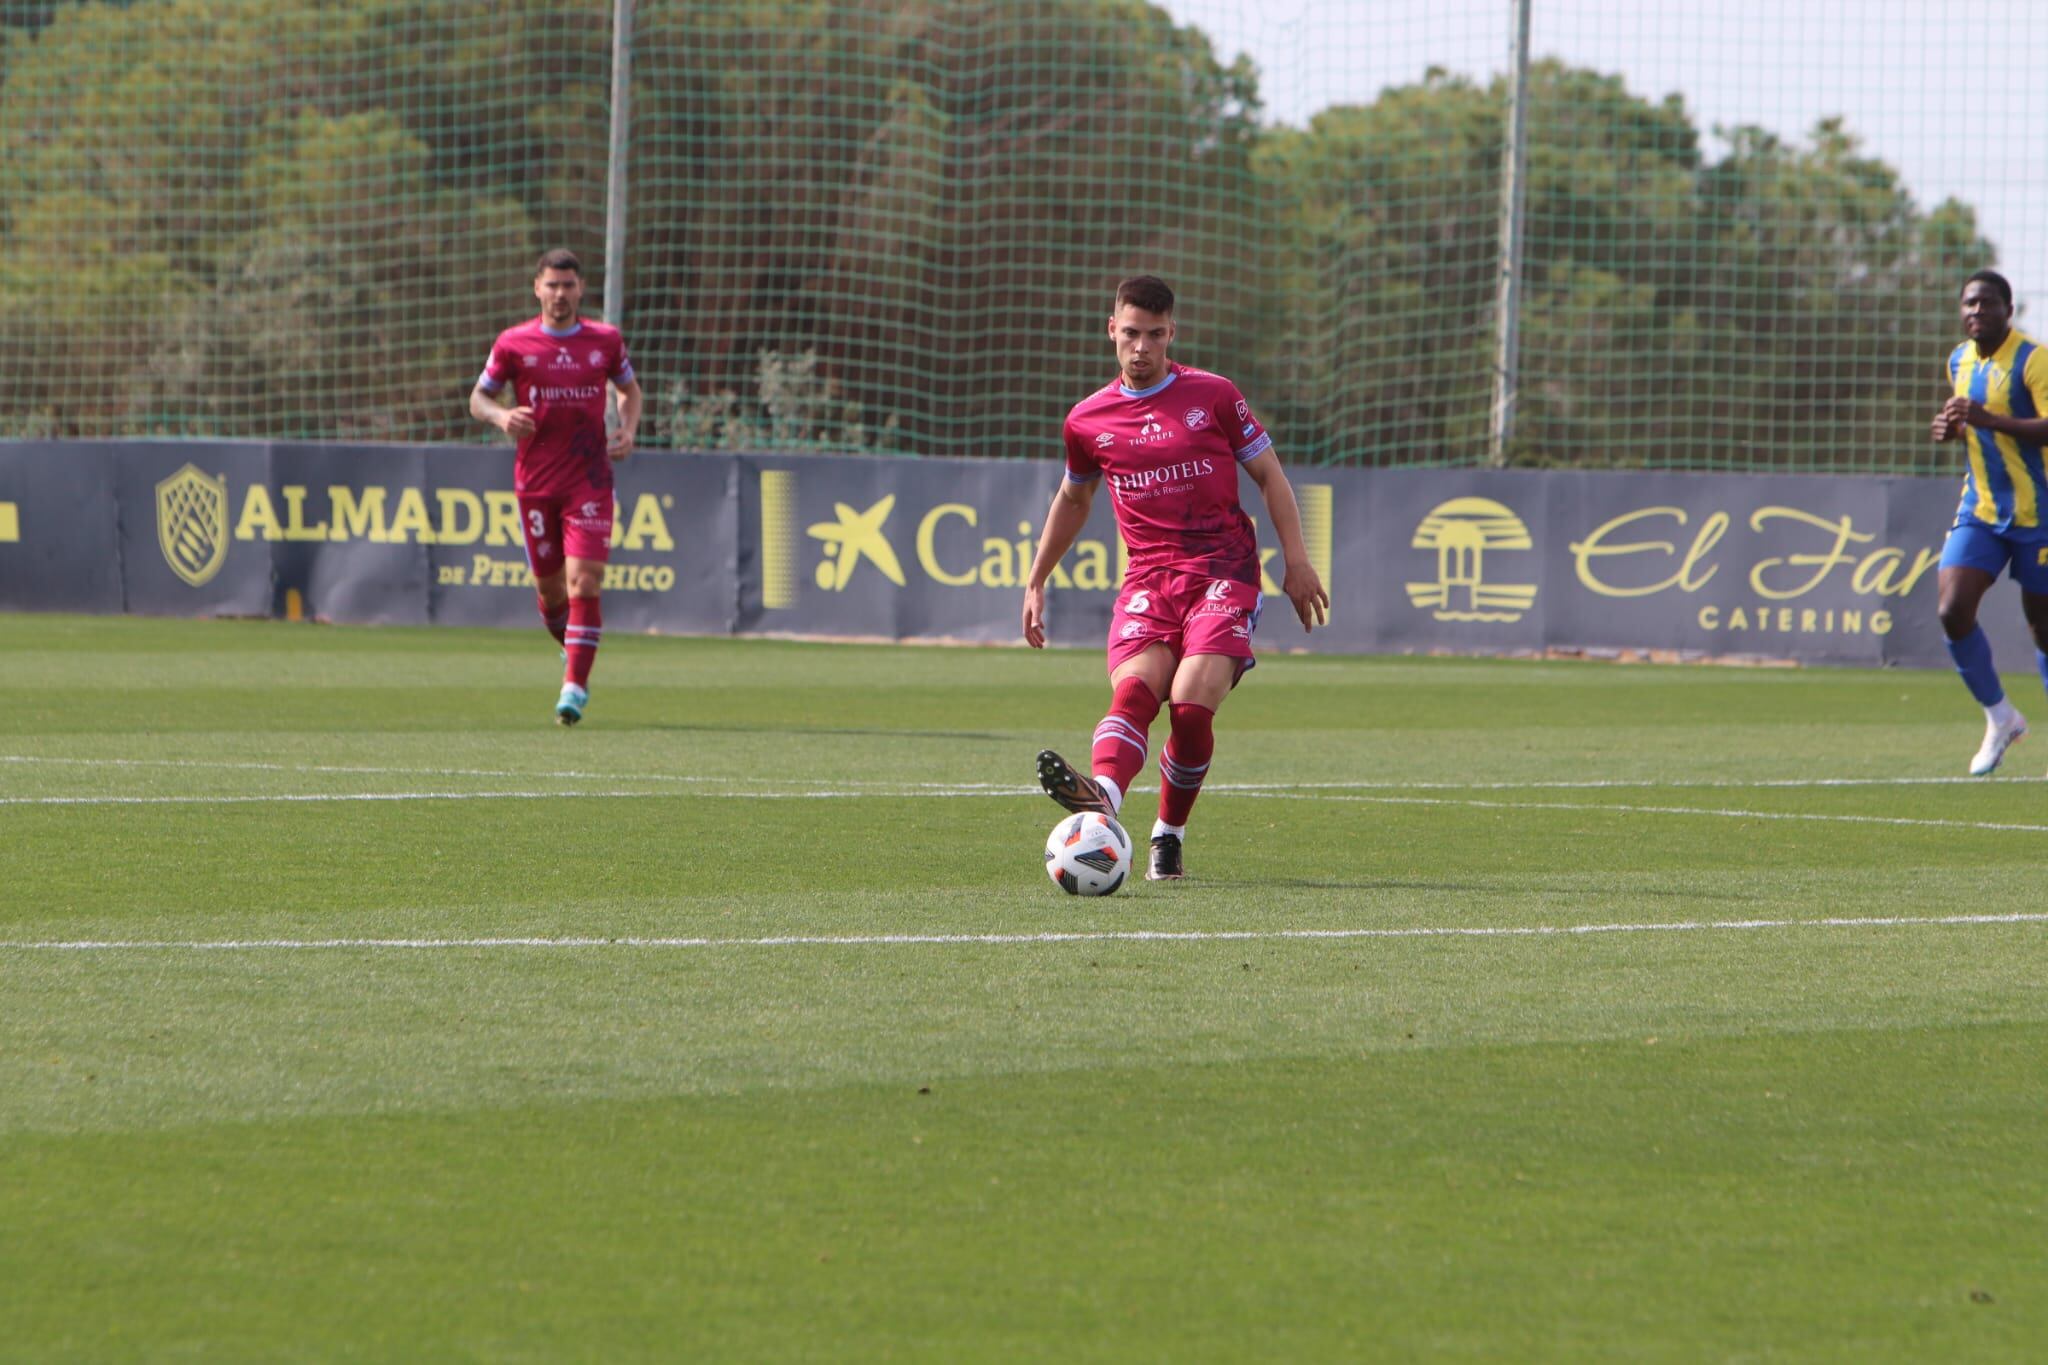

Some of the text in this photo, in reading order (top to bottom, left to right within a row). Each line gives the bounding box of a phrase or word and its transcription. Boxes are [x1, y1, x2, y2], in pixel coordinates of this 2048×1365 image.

[1128, 431, 1175, 447] TIO PEPE
[1123, 458, 1214, 489] HIPOTELS
[1127, 490, 1152, 501] Hotels
[1162, 483, 1195, 496] Resorts
[234, 483, 675, 551] ALMADRA
[528, 508, 547, 537] 3
[915, 502, 1286, 597] Caiak
[1569, 505, 1942, 600] El Far
[602, 564, 675, 592] HICO
[1123, 590, 1151, 615] 6
[1699, 606, 1893, 635] CATERING
